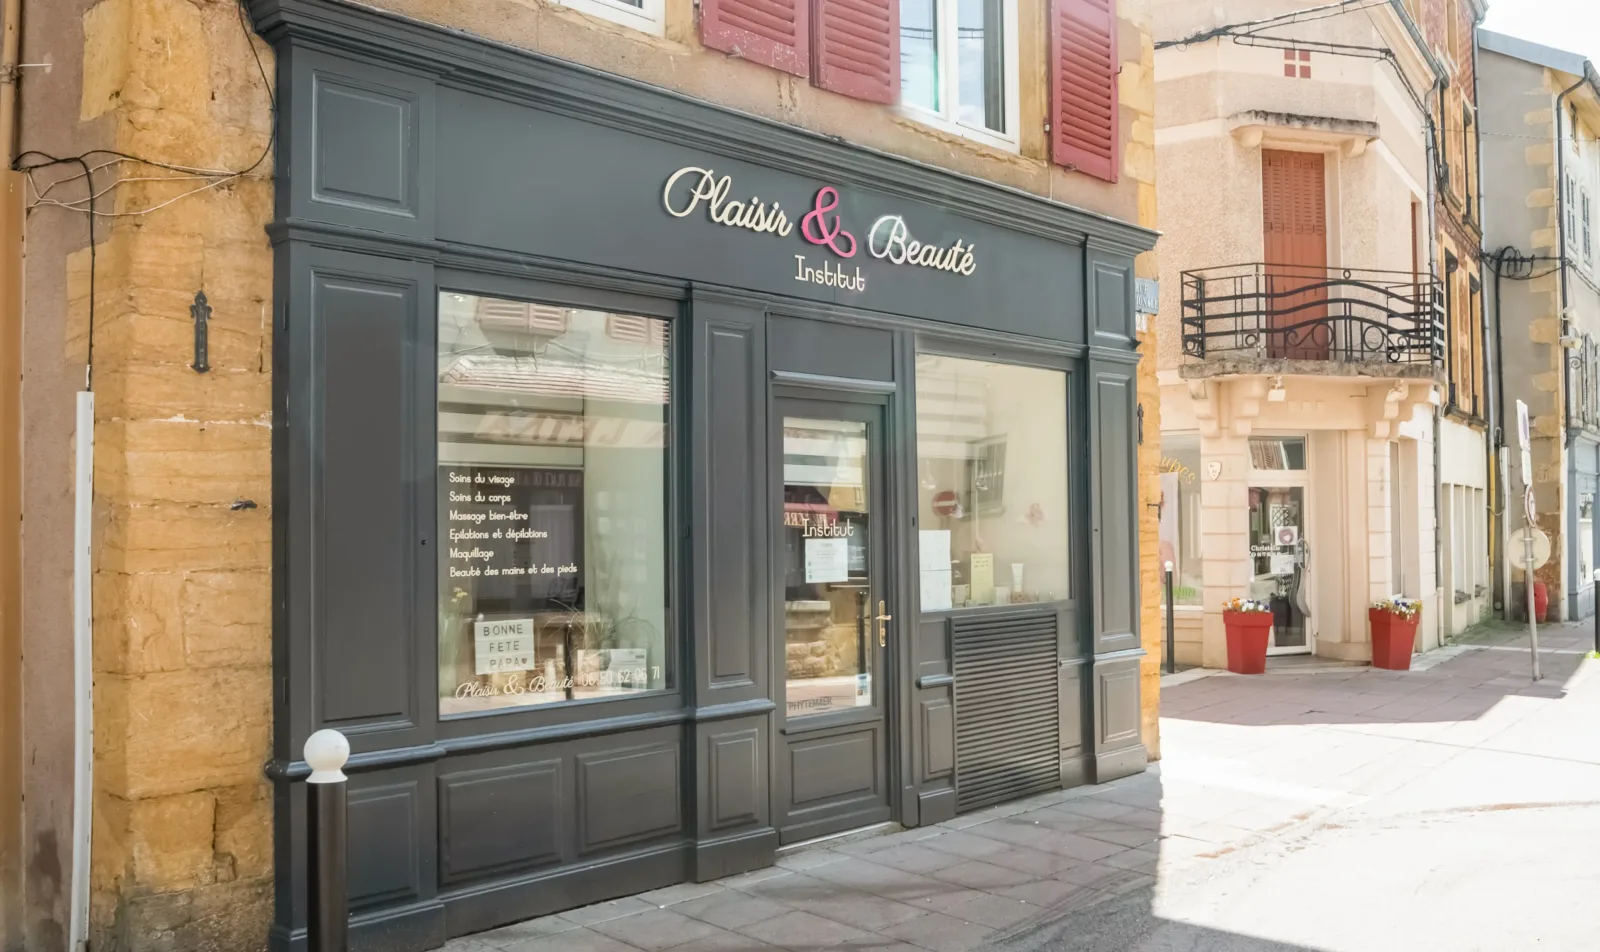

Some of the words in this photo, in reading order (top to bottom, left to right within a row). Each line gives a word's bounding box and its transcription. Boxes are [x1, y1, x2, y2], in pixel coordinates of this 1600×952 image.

[663, 166, 793, 237] Plaisir
[801, 186, 857, 258] &
[867, 215, 977, 276] Beauté
[794, 254, 866, 293] Institut
[449, 472, 472, 484] Soins
[474, 471, 486, 484] du
[488, 473, 515, 488] visage
[449, 490, 472, 502] Soins
[474, 490, 486, 503] du
[488, 494, 512, 506] corps
[449, 509, 487, 524] Massage
[488, 508, 529, 521] bien-être
[449, 527, 490, 544] Epilations
[492, 528, 503, 539] et
[505, 528, 548, 542] dépilations
[802, 517, 855, 538] Institut
[449, 547, 495, 562] Maquillage
[450, 566, 482, 578] Beauté
[484, 566, 500, 577] des
[501, 565, 526, 577] mains
[527, 564, 539, 576] et
[540, 563, 555, 575] des
[557, 562, 578, 578] pieds
[482, 622, 525, 637] BONNE
[488, 639, 521, 653] FETE
[489, 656, 521, 669] PAPA
[455, 680, 500, 701] Plaisir
[502, 673, 526, 697] &
[528, 673, 576, 693] Beauté
[651, 665, 661, 681] 71
